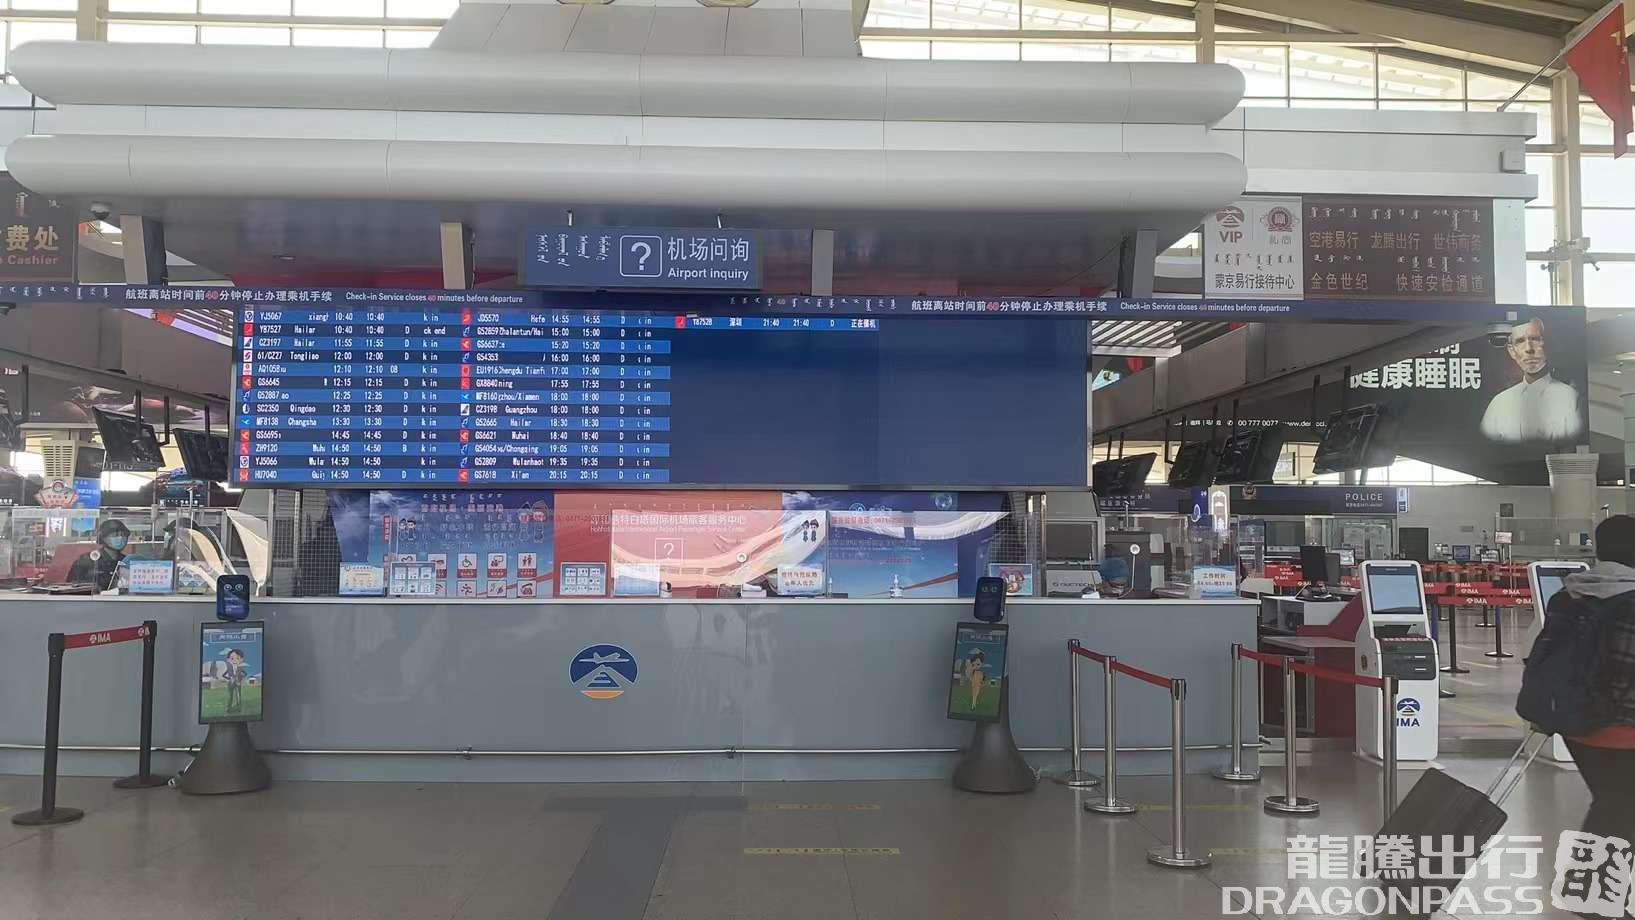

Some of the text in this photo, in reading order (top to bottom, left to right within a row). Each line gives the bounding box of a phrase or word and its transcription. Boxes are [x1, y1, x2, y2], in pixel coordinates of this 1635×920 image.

[0, 223, 59, 252] 费处
[1219, 231, 1243, 243] VIP
[1309, 230, 1359, 249] 空港易行
[667, 237, 750, 262] 机场问询
[7, 254, 59, 265] Cashier
[667, 267, 749, 281] Airport inquiry
[1311, 272, 1484, 292] 金色世纪 快速安检通道
[345, 291, 377, 301] Check-in
[378, 292, 404, 301] Service
[405, 293, 427, 301] closes
[437, 293, 465, 302] minutes
[466, 293, 488, 302] before
[489, 294, 523, 304] departure
[1120, 302, 1151, 310] Check-in
[1151, 302, 1176, 310] Service
[1177, 303, 1198, 311] closes
[1207, 303, 1235, 311] minutes
[1235, 303, 1257, 312] before
[1258, 304, 1290, 313] departure
[335, 312, 353, 321] 10:40
[367, 312, 385, 321] 10:40
[552, 314, 570, 323] 14:55
[583, 315, 600, 324] 14:55
[763, 319, 780, 328] 21:40
[793, 319, 810, 328] 21:40
[334, 325, 353, 334] 10:40
[366, 325, 384, 334] 10:40
[551, 327, 569, 336] 15:00
[582, 328, 601, 337] 15:00
[334, 338, 353, 347] 11:55
[366, 338, 384, 347] 11:55
[551, 340, 569, 349] 15:20
[582, 341, 600, 350] 15:20
[334, 351, 352, 360] 12:00
[366, 351, 384, 361] 12:00
[551, 353, 569, 362] 16:00
[582, 354, 600, 363] 16:00
[334, 364, 352, 373] 12:10
[365, 365, 384, 374] 12:10
[551, 366, 569, 375] 17:00
[582, 367, 600, 375] 17:00
[1349, 357, 1482, 390] 健康睡眠
[333, 377, 352, 387] 12:15
[365, 378, 383, 387] 12:15
[551, 379, 569, 388] 17:55
[582, 380, 600, 389] 17:55
[333, 391, 351, 400] 12:25
[364, 391, 383, 400] 12:25
[551, 392, 568, 401] 18:00
[582, 392, 600, 401] 18:00
[290, 405, 316, 414] Qingdao
[332, 404, 351, 413] 12:30
[364, 404, 383, 413] 12:30
[505, 405, 538, 414] Guangzhou
[550, 405, 568, 414] 18:00
[581, 405, 600, 414] 18:00
[287, 418, 317, 428] Changsha
[332, 417, 350, 426] 13:30
[364, 417, 382, 426] 13:30
[550, 418, 568, 427] 18:30
[581, 418, 599, 427] 18:30
[332, 430, 350, 439] 14:45
[363, 430, 382, 439] 14:45
[550, 431, 568, 440] 18:40
[581, 431, 599, 440] 18:40
[332, 443, 350, 452] 14:50
[363, 444, 382, 452] 14:50
[550, 444, 568, 453] 19:05
[581, 444, 599, 453] 19:05
[331, 457, 349, 466] 14:50
[363, 457, 381, 466] 14:50
[549, 457, 568, 466] 19:35
[581, 457, 599, 466] 19:35
[331, 470, 349, 479] 14:50
[362, 470, 381, 479] 14:50
[549, 470, 567, 479] 20:15
[580, 470, 598, 479] 20:15
[1345, 493, 1383, 502] POLICE
[97, 631, 111, 643] IMA
[1396, 718, 1420, 727] IMA
